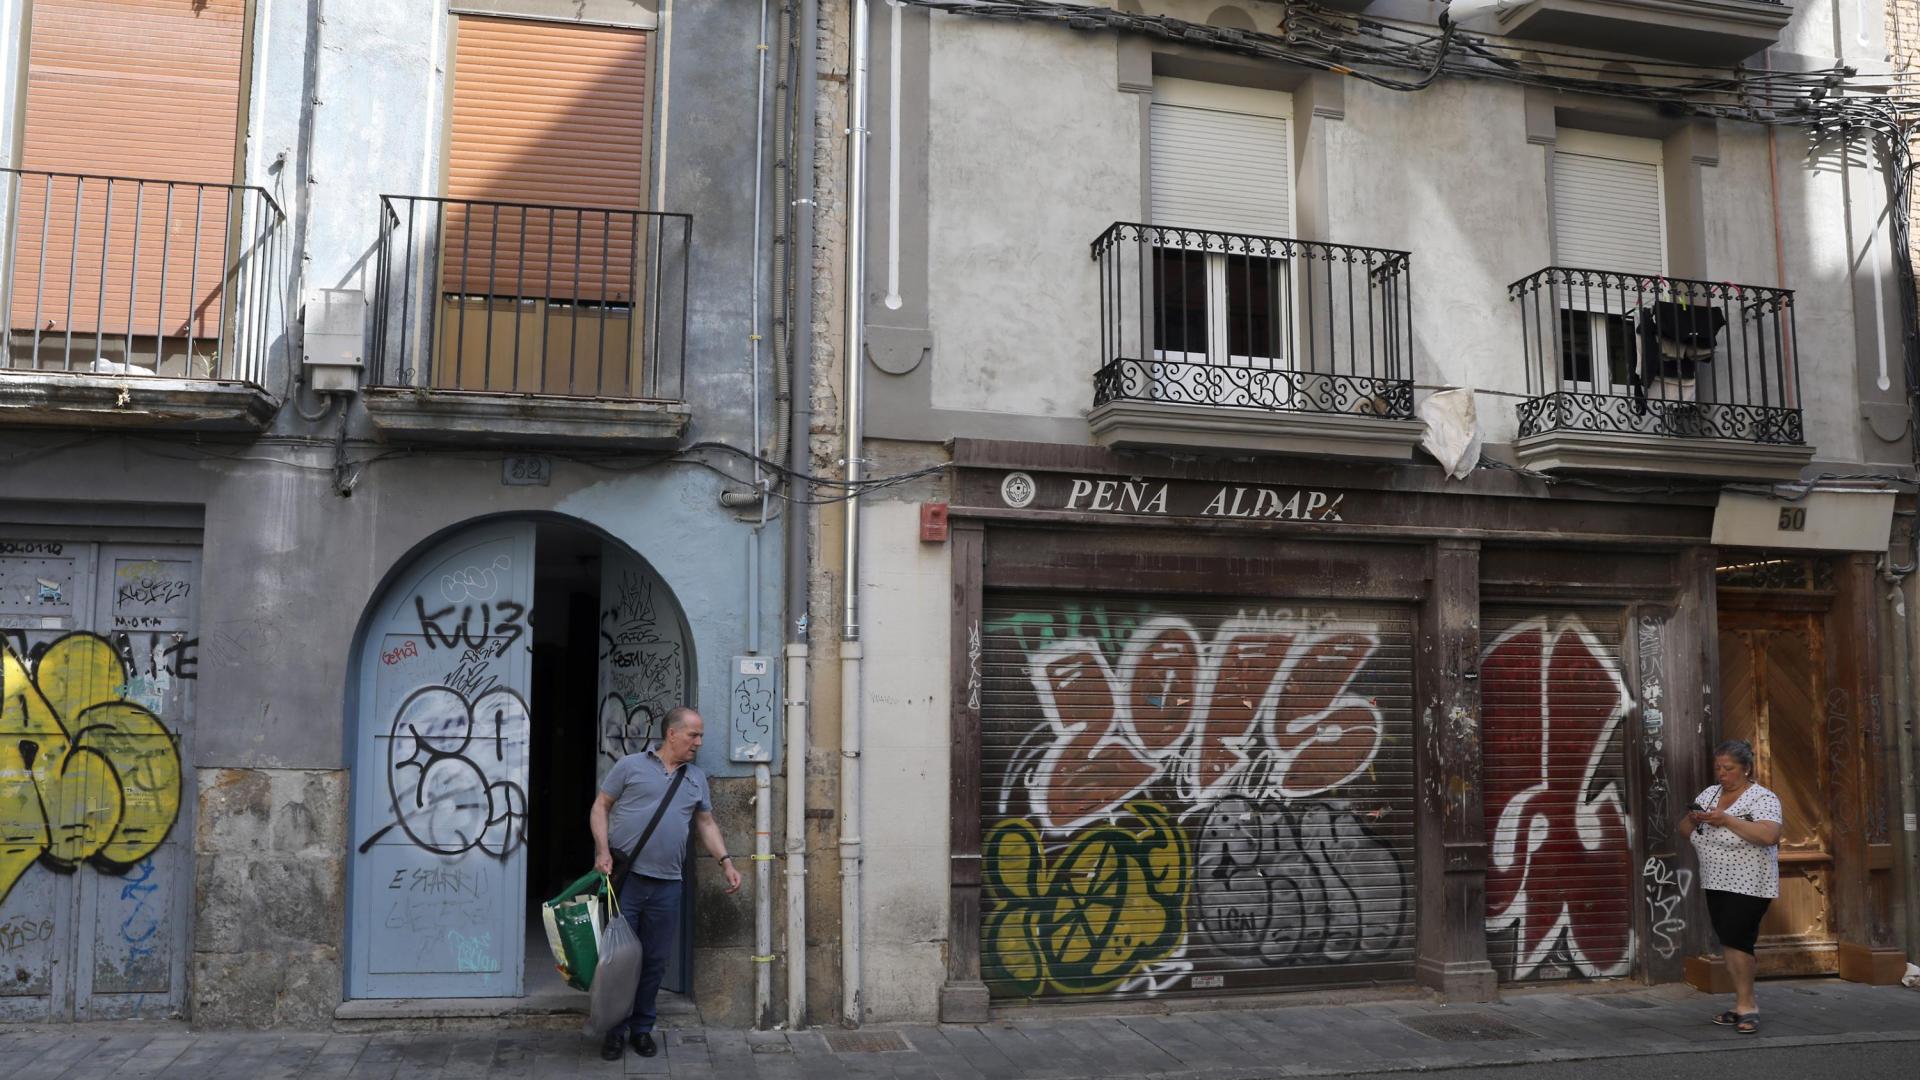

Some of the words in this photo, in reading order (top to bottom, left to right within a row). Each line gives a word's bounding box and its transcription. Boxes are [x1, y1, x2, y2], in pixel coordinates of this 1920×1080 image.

[1064, 475, 1169, 513] PEÑA
[1200, 486, 1344, 521] ALDAPA
[1778, 508, 1805, 530] 50
